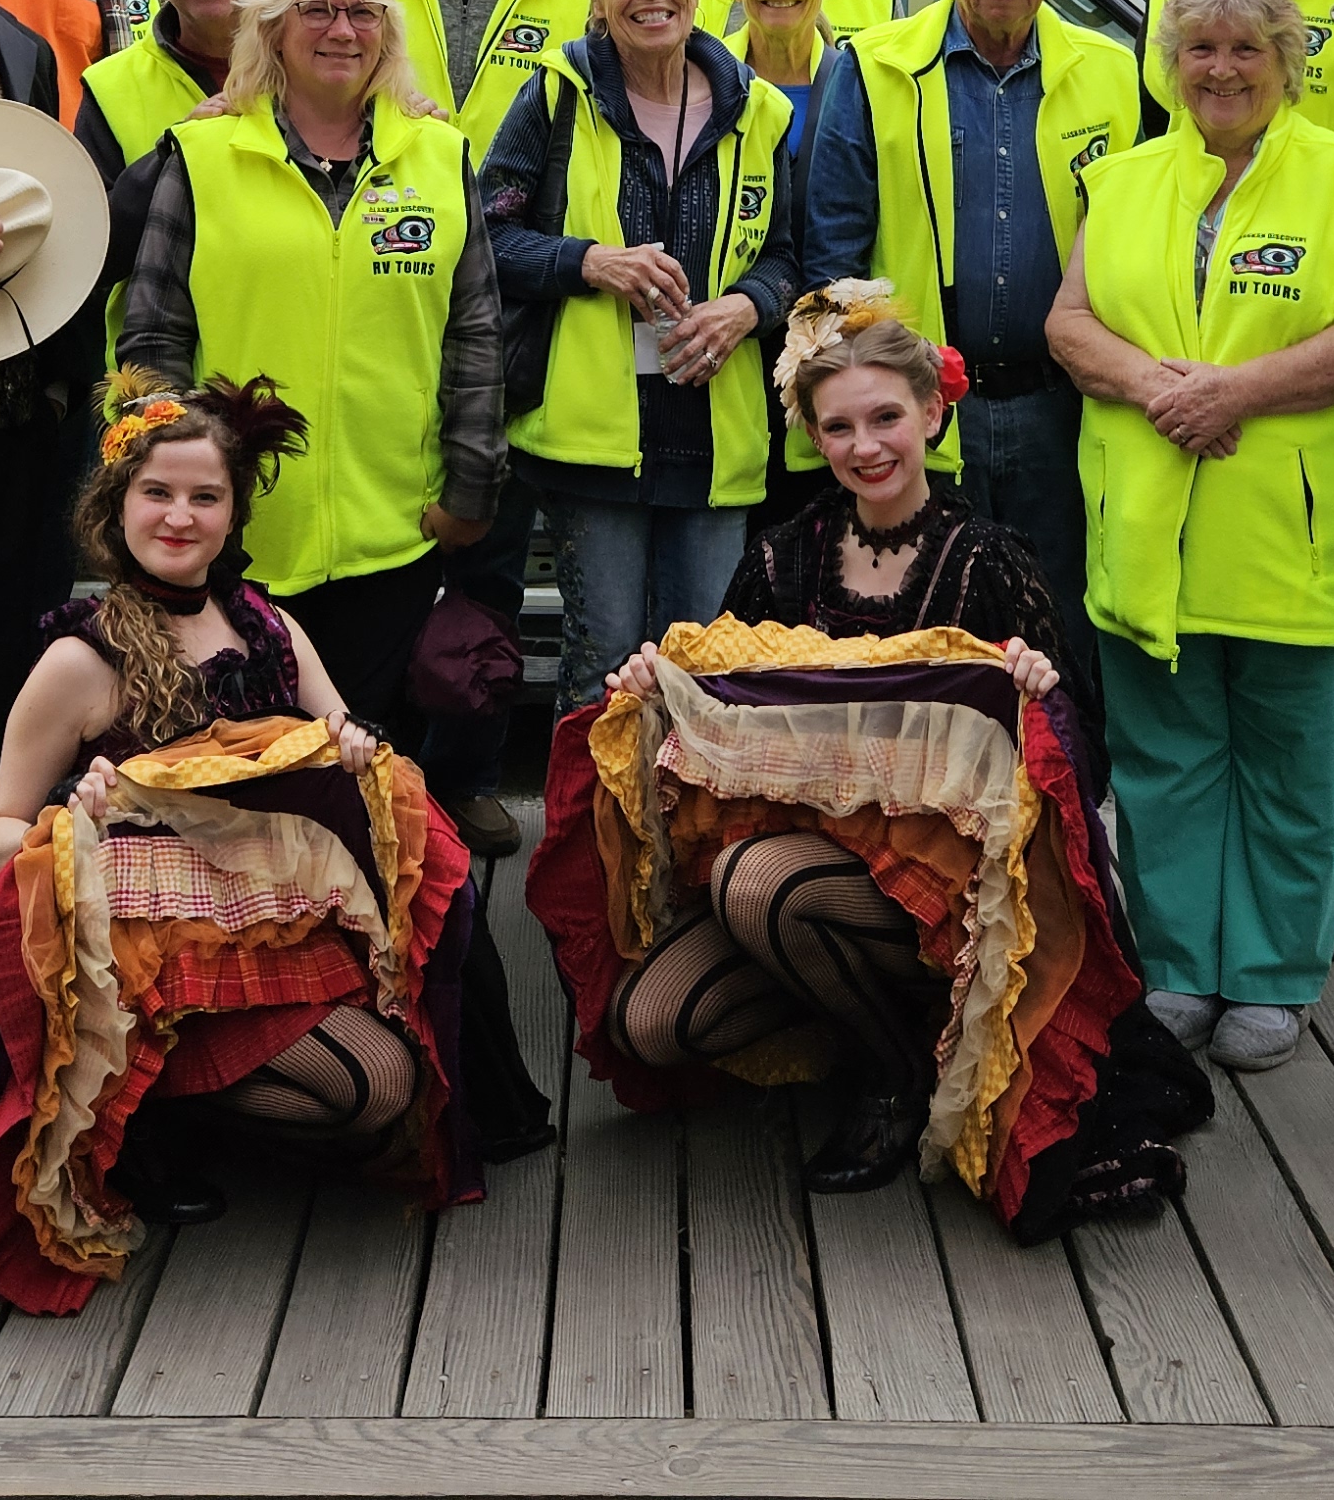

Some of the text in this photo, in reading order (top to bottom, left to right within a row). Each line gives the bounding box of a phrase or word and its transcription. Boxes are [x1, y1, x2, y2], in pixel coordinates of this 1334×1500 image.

[490, 54, 539, 71] RV TOUR
[743, 175, 767, 183] COVERY
[738, 225, 765, 242] TOURS
[372, 260, 435, 276] RV TOURS
[1229, 281, 1302, 301] RV TOURS
